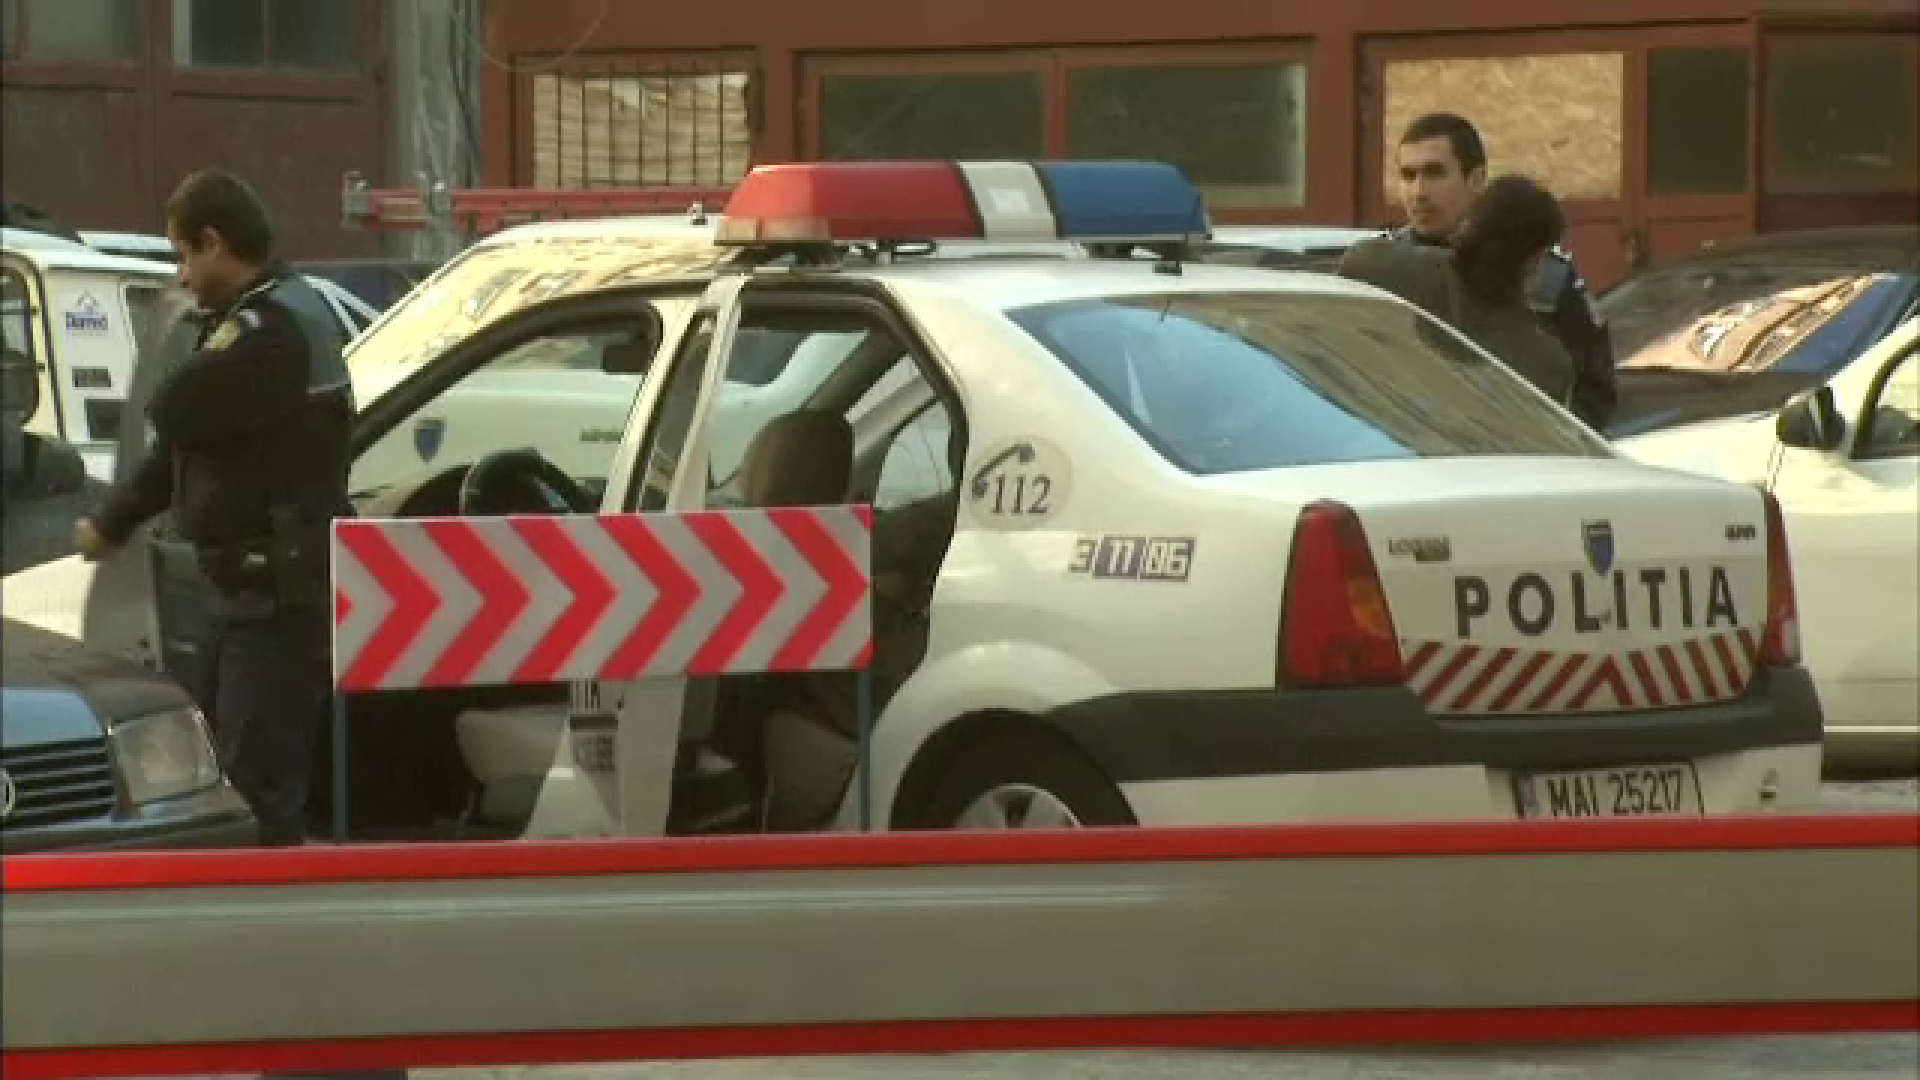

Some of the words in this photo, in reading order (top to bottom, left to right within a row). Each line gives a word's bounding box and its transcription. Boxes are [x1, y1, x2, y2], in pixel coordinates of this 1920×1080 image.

[990, 474, 1051, 515] 112
[1454, 566, 1738, 639] POLITIA
[1547, 775, 1600, 816] MAI
[1607, 768, 1682, 816] 25217
